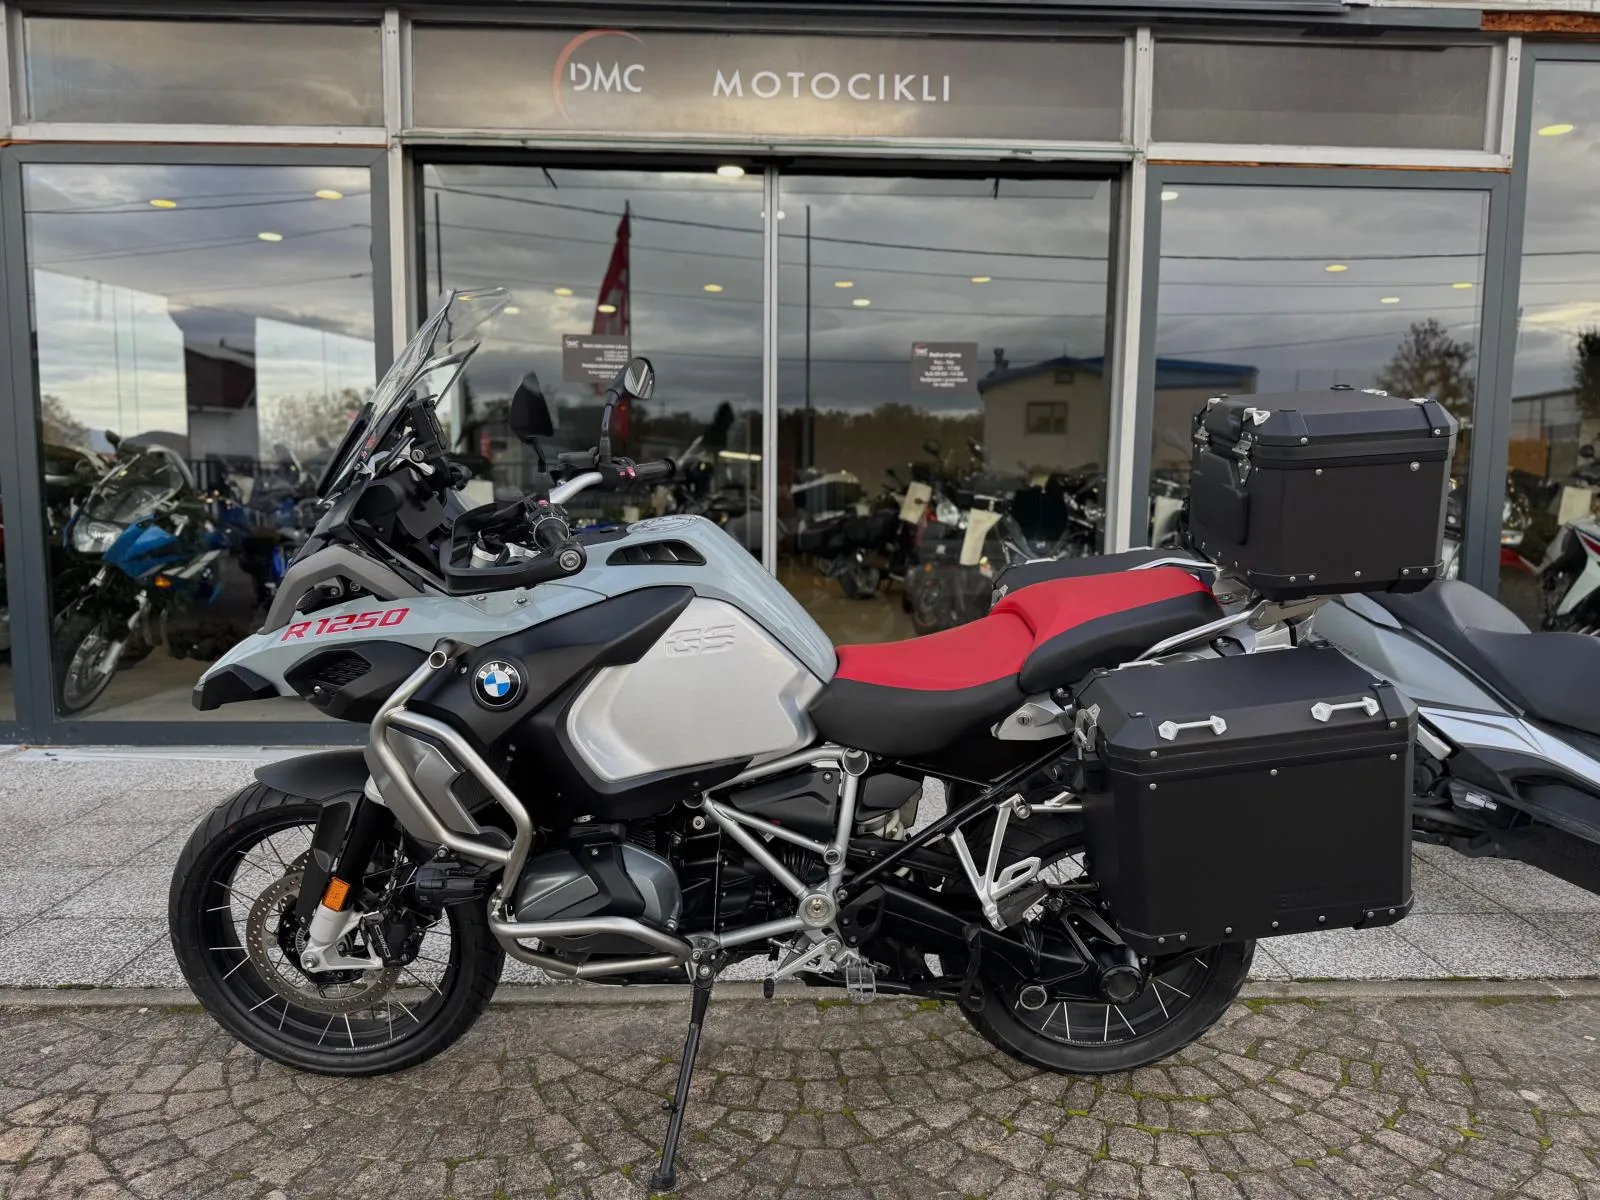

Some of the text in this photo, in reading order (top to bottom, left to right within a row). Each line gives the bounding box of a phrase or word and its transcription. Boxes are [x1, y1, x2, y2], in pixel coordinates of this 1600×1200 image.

[570, 61, 950, 102] DMC MOTOCIKLI
[280, 607, 411, 642] R 1250
[664, 624, 736, 658] GS
[479, 663, 515, 680] BMW
